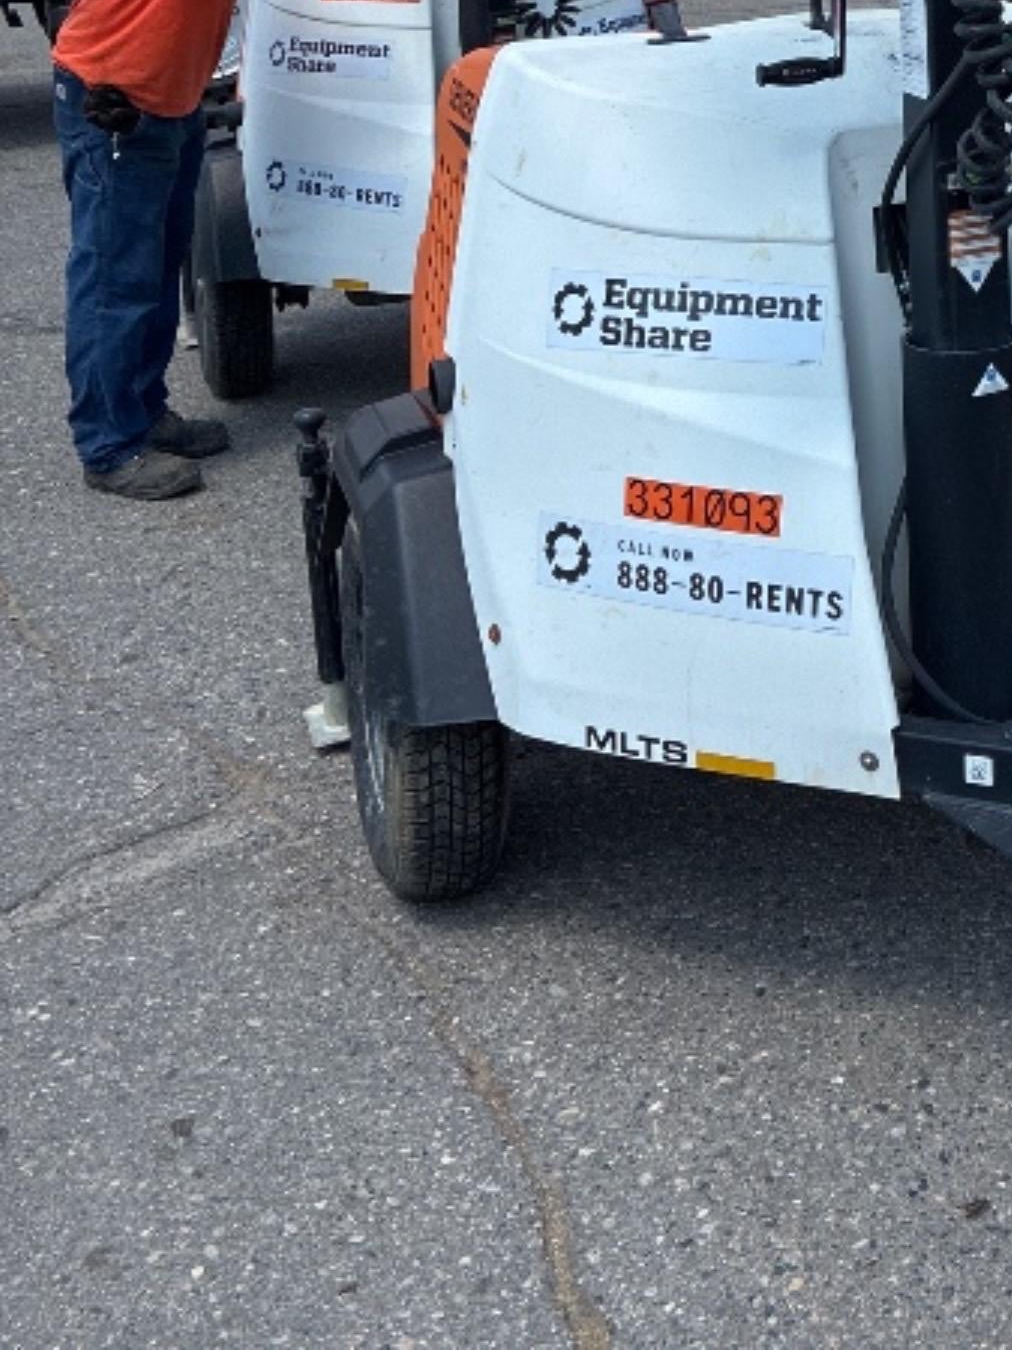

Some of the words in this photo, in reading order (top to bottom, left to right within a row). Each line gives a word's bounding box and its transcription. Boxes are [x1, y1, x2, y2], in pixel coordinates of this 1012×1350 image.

[287, 56, 336, 73] Share
[289, 36, 391, 58] Equipment
[603, 279, 823, 321] Equipment
[600, 316, 712, 351] Share
[627, 479, 780, 535] 331093
[617, 539, 653, 556] CALL
[661, 545, 694, 562] NOW
[617, 560, 844, 620] 888-80-RENTS
[585, 725, 688, 763] MLTS
